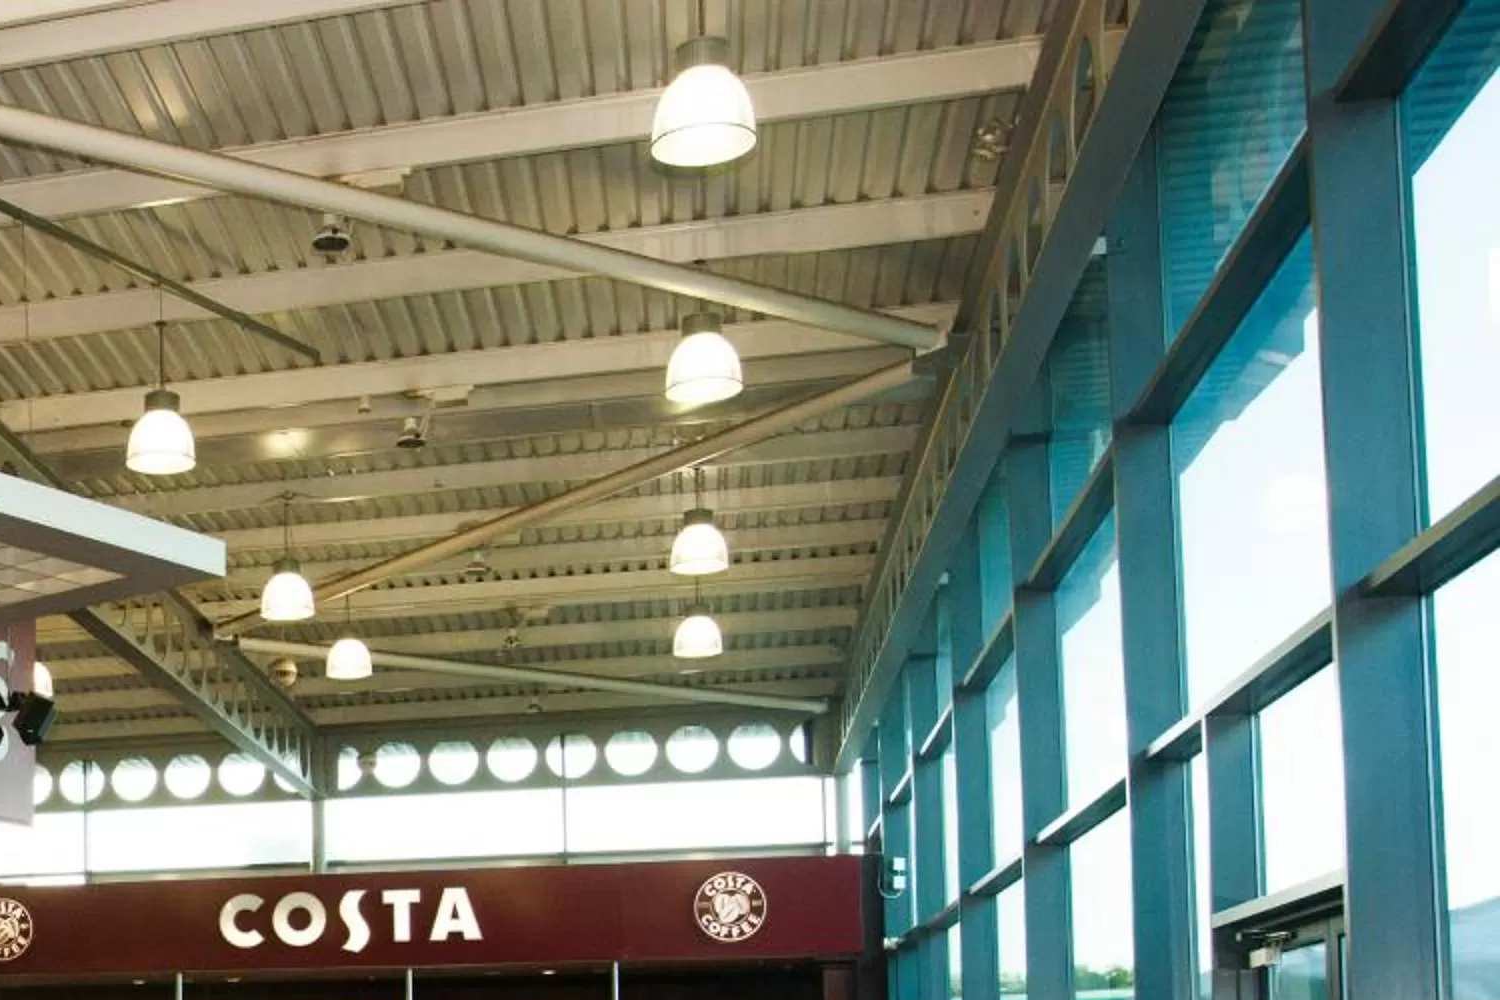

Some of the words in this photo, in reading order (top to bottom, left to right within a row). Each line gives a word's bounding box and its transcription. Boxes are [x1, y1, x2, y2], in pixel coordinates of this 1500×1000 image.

[704, 876, 754, 897] COSTA
[219, 887, 484, 953] COSTA
[701, 914, 761, 937] COFFEE
